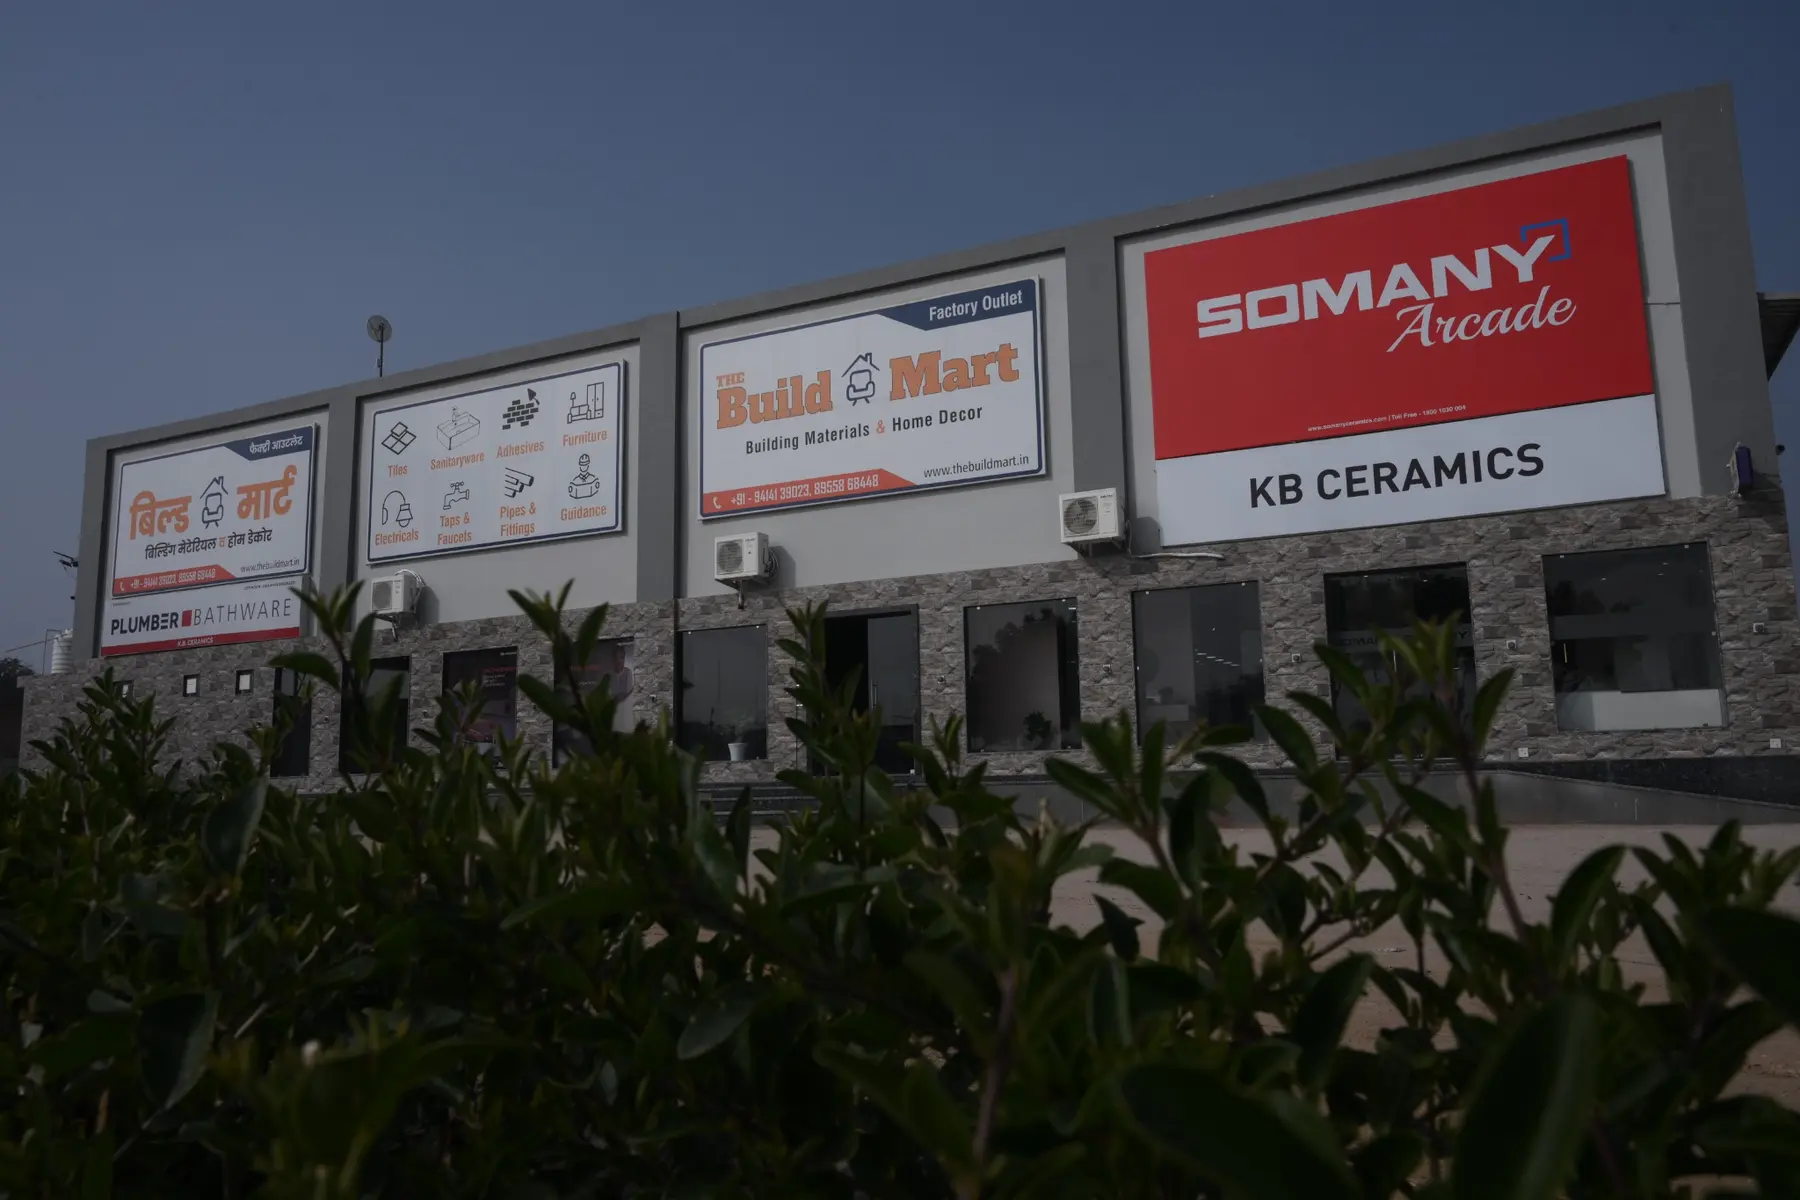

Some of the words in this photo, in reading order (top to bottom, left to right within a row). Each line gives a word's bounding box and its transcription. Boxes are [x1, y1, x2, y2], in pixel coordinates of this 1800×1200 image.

[1196, 234, 1557, 338] SOMANY
[929, 299, 978, 321] Factory
[982, 289, 1023, 311] Outlet
[1386, 285, 1577, 353] Arcade
[716, 371, 745, 387] THE
[716, 370, 834, 429] Build
[889, 342, 1020, 401] Mart
[1403, 411, 1418, 419] Free
[562, 430, 608, 446] Furniture
[745, 432, 799, 455] Building
[804, 422, 870, 446] Materials
[876, 419, 886, 434] &
[892, 411, 933, 432] Home
[939, 405, 983, 425] Decor
[271, 435, 303, 451] आउटलेट
[496, 440, 545, 458] Adhesives
[430, 452, 485, 471] Sanitaryware
[923, 453, 1029, 478] www.thebuildmart.in
[387, 464, 408, 478] Tiles
[1249, 472, 1303, 509] KB
[1316, 443, 1545, 500] CERAMICS
[730, 491, 746, 506] +91
[754, 487, 778, 504] 94141
[814, 477, 845, 496] 89558
[847, 473, 879, 492] 68448
[129, 490, 192, 540] बिल्ड
[236, 465, 297, 521] मार्ट
[440, 515, 461, 529] Taps
[463, 512, 470, 524] &
[500, 505, 526, 522] Pipes
[529, 503, 537, 515] &
[560, 504, 607, 521] Guidance
[375, 528, 419, 546] Electricals
[437, 532, 472, 545] Faucets
[500, 521, 535, 539] Fittings
[227, 531, 245, 548] होम
[110, 611, 179, 635] PLUMBER
[193, 598, 292, 626] BATHWARE
[187, 636, 214, 646] CERAMICS
